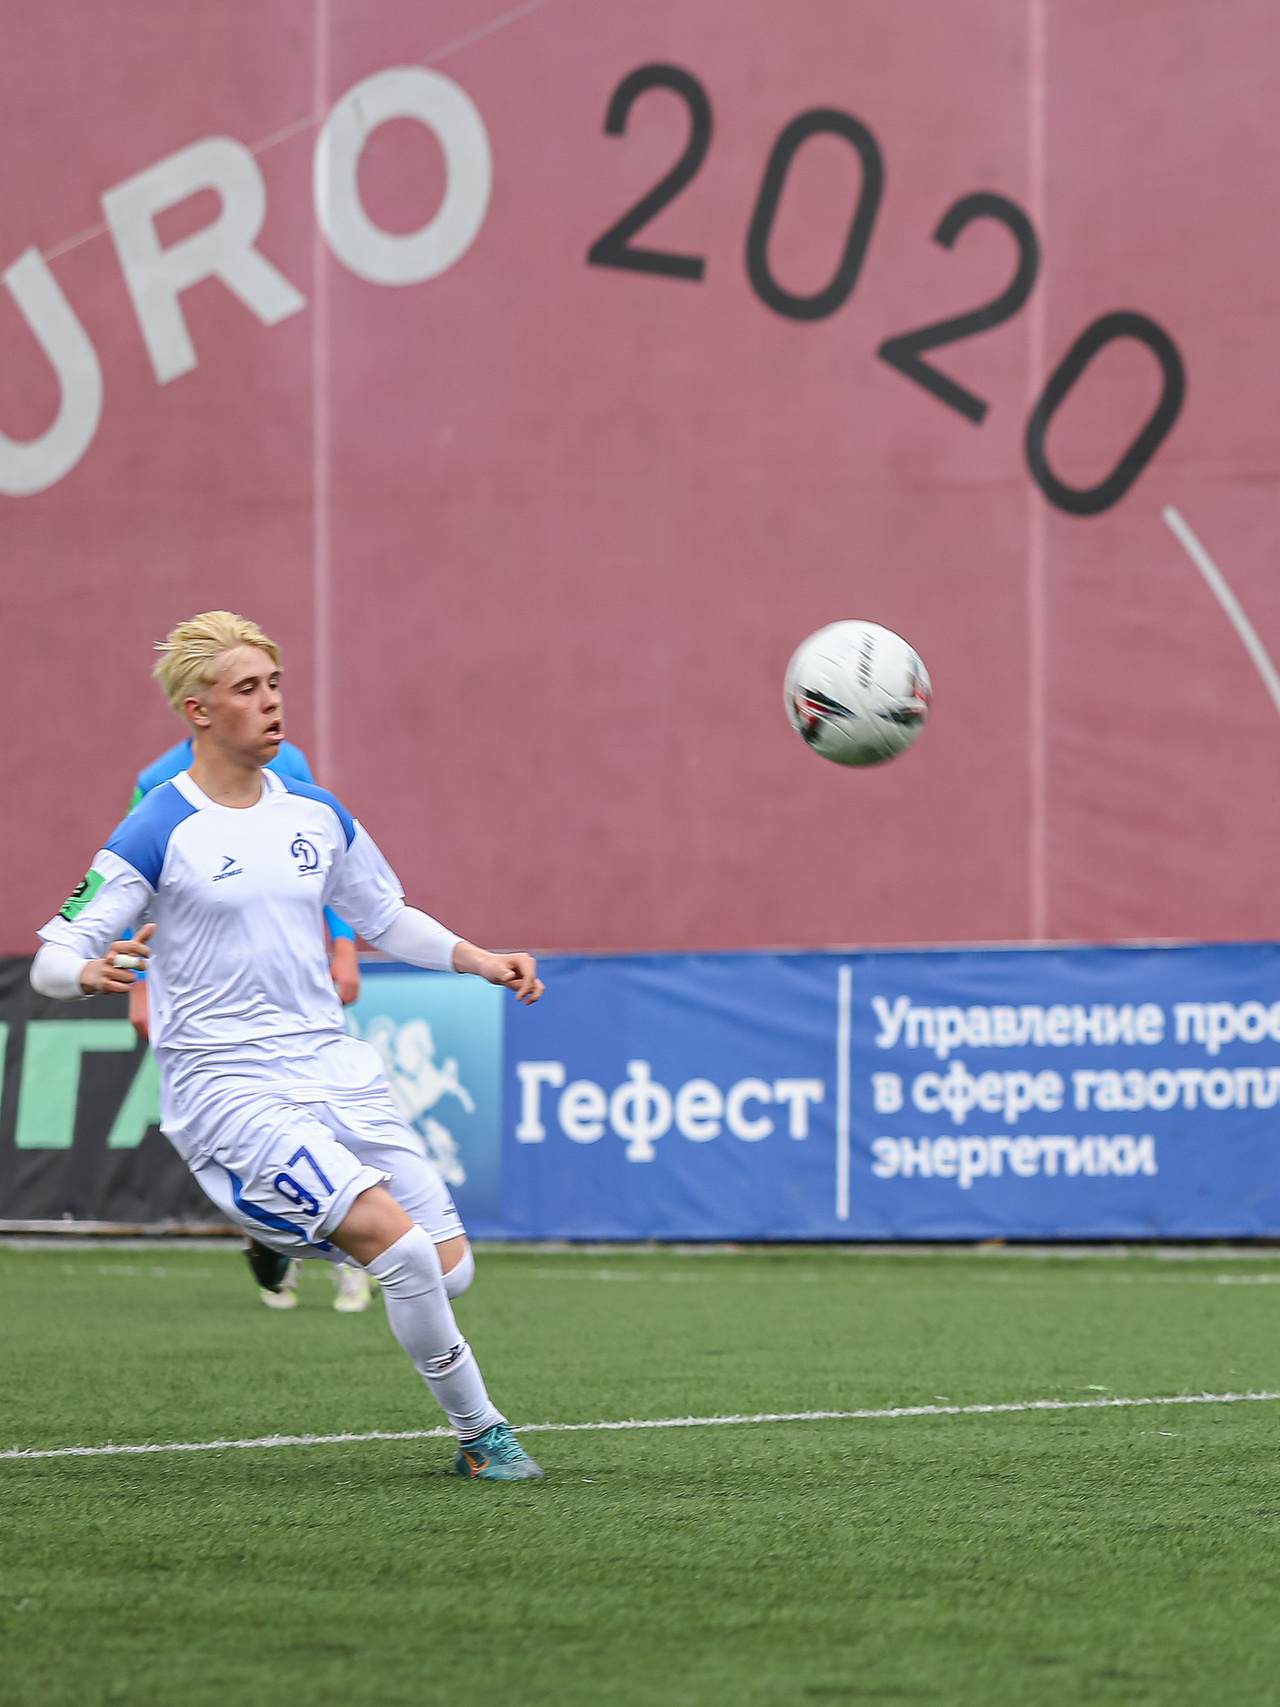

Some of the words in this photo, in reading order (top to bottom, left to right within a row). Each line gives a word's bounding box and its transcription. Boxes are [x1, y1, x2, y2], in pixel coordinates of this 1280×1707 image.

[587, 63, 1187, 518] 2020
[872, 995, 1166, 1060] Управление
[515, 1059, 826, 1163] Гефест
[871, 1071, 903, 1114] в
[911, 1059, 1065, 1125] сфере
[274, 1145, 336, 1217] 97
[871, 1133, 1159, 1190] энергетики
